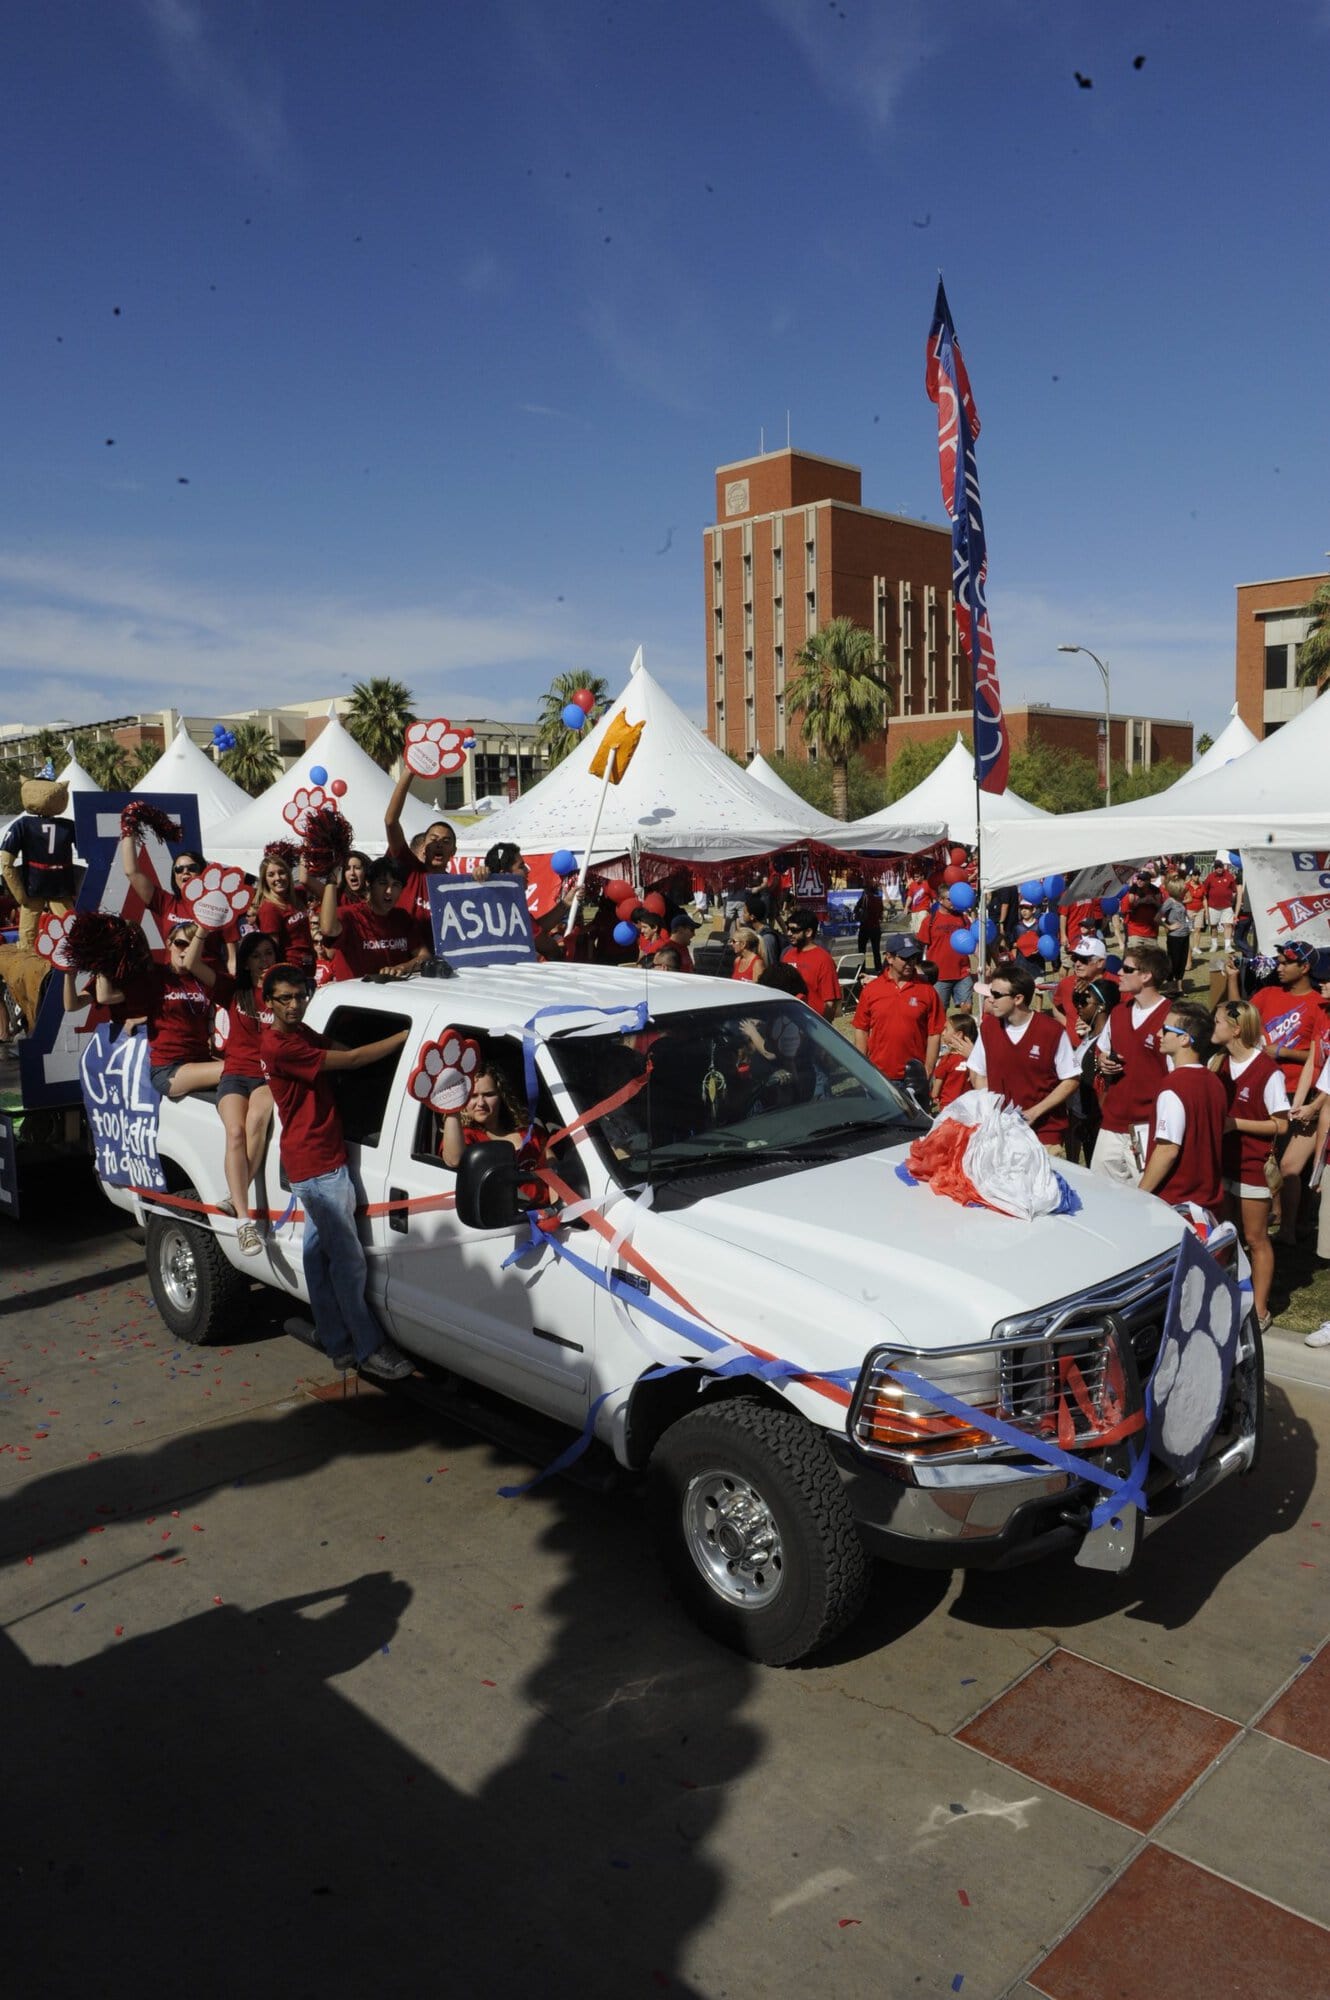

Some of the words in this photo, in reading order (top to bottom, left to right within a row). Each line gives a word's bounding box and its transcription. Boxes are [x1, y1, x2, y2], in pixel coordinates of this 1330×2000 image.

[42, 824, 56, 854] 7
[441, 900, 528, 941] ASUA
[81, 1032, 154, 1113] CAL
[93, 1108, 120, 1142] too
[103, 1144, 118, 1176] to
[120, 1151, 153, 1188] quit
